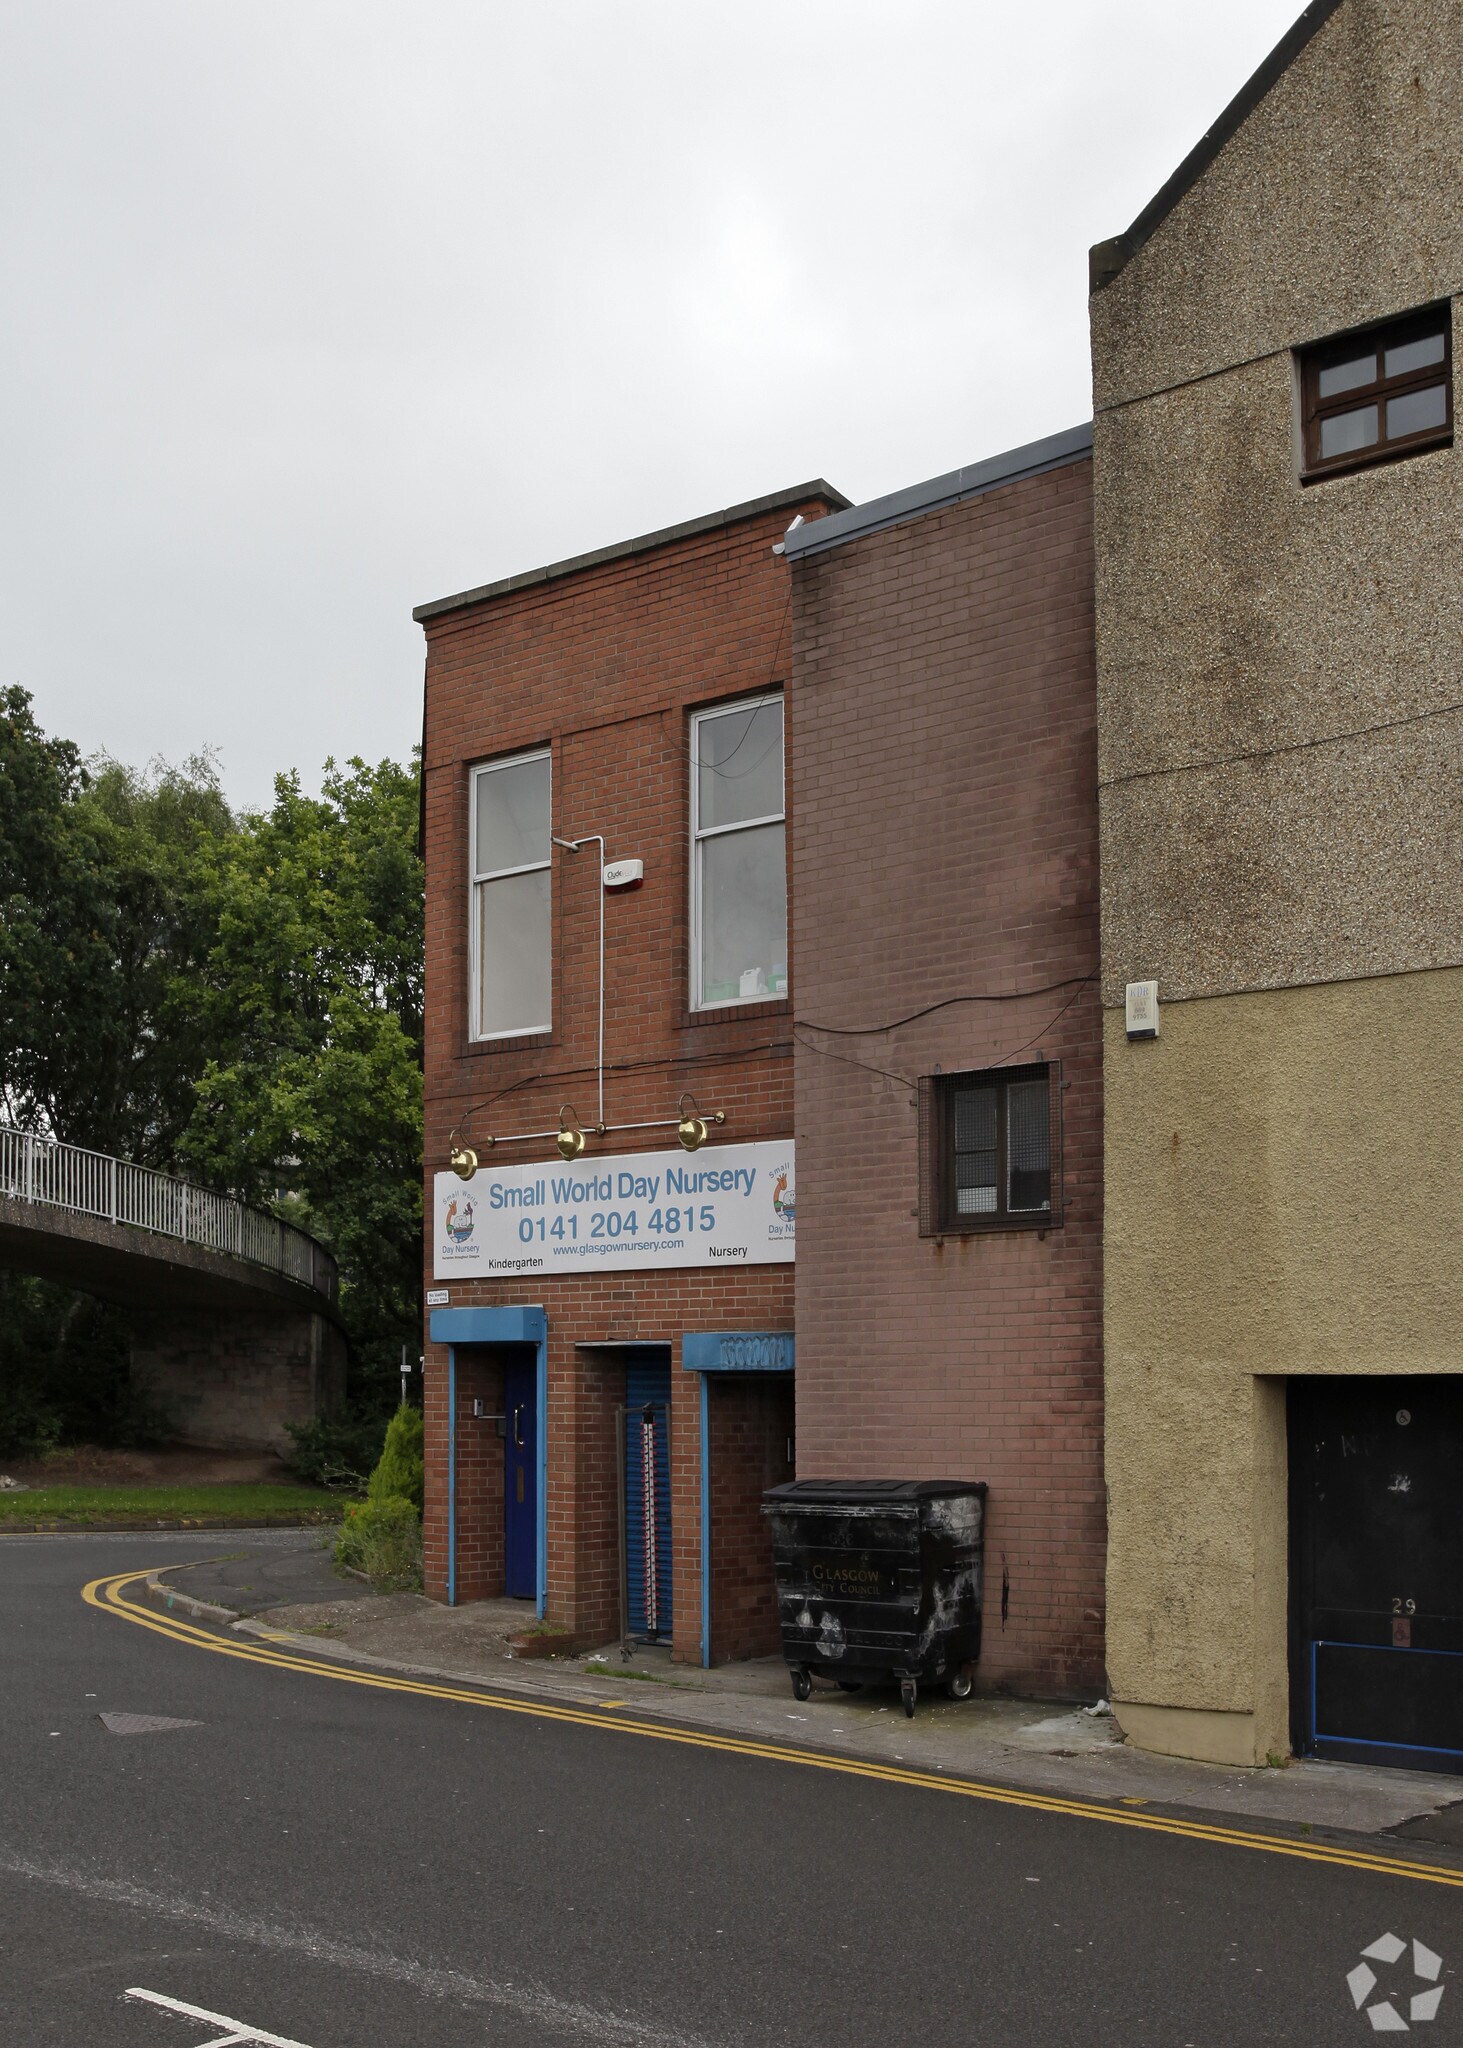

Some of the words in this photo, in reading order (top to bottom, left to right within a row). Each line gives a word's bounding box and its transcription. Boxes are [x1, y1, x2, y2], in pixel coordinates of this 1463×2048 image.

[768, 1162, 790, 1179] Small
[489, 1179, 546, 1210] Small
[551, 1173, 612, 1205] World
[618, 1172, 660, 1204] Day
[666, 1167, 757, 1197] Nursery
[443, 1189, 459, 1205] Small
[462, 1189, 478, 1207] World
[518, 1214, 578, 1243] 0141
[590, 1210, 639, 1238] 204
[647, 1205, 716, 1234] 4815
[768, 1224, 783, 1235] Day
[442, 1245, 455, 1255] Day
[455, 1244, 480, 1254] Nursery
[553, 1239, 684, 1257] www.glasgownursery.com
[709, 1246, 748, 1259] Nursery
[489, 1257, 543, 1270] Kindergarten
[813, 1564, 879, 1582] GLASGOW
[1391, 1597, 1416, 1615] 29
